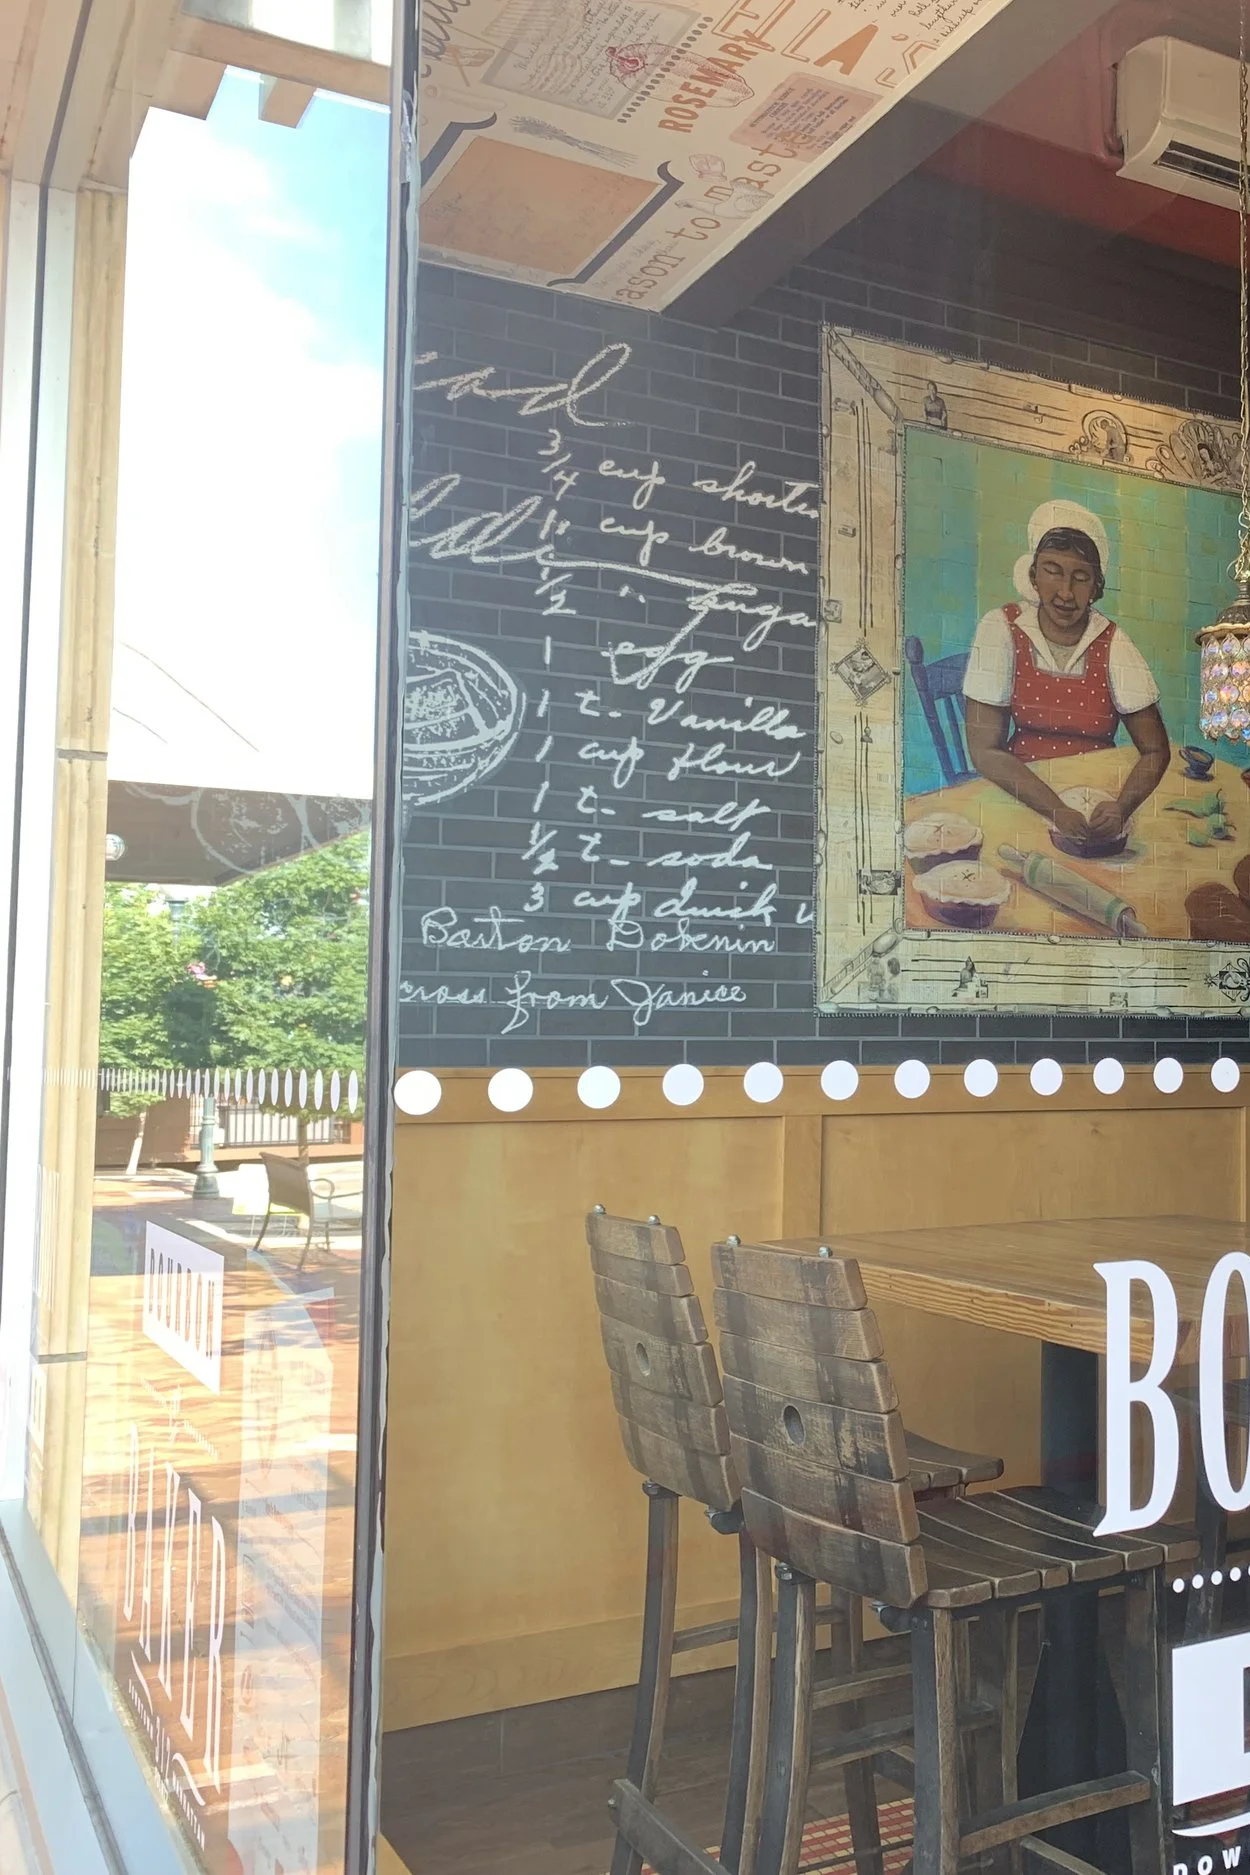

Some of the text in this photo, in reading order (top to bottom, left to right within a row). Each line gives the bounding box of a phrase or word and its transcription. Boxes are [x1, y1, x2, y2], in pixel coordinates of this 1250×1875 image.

[658, 28, 774, 134] ROSEMARY
[599, 460, 665, 510] cup
[600, 517, 669, 566] cup
[688, 527, 808, 575] brown
[577, 736, 646, 788] cup
[642, 798, 771, 832] salt
[646, 832, 773, 871] soda
[501, 970, 609, 1034] from
[610, 969, 747, 1026] Janice
